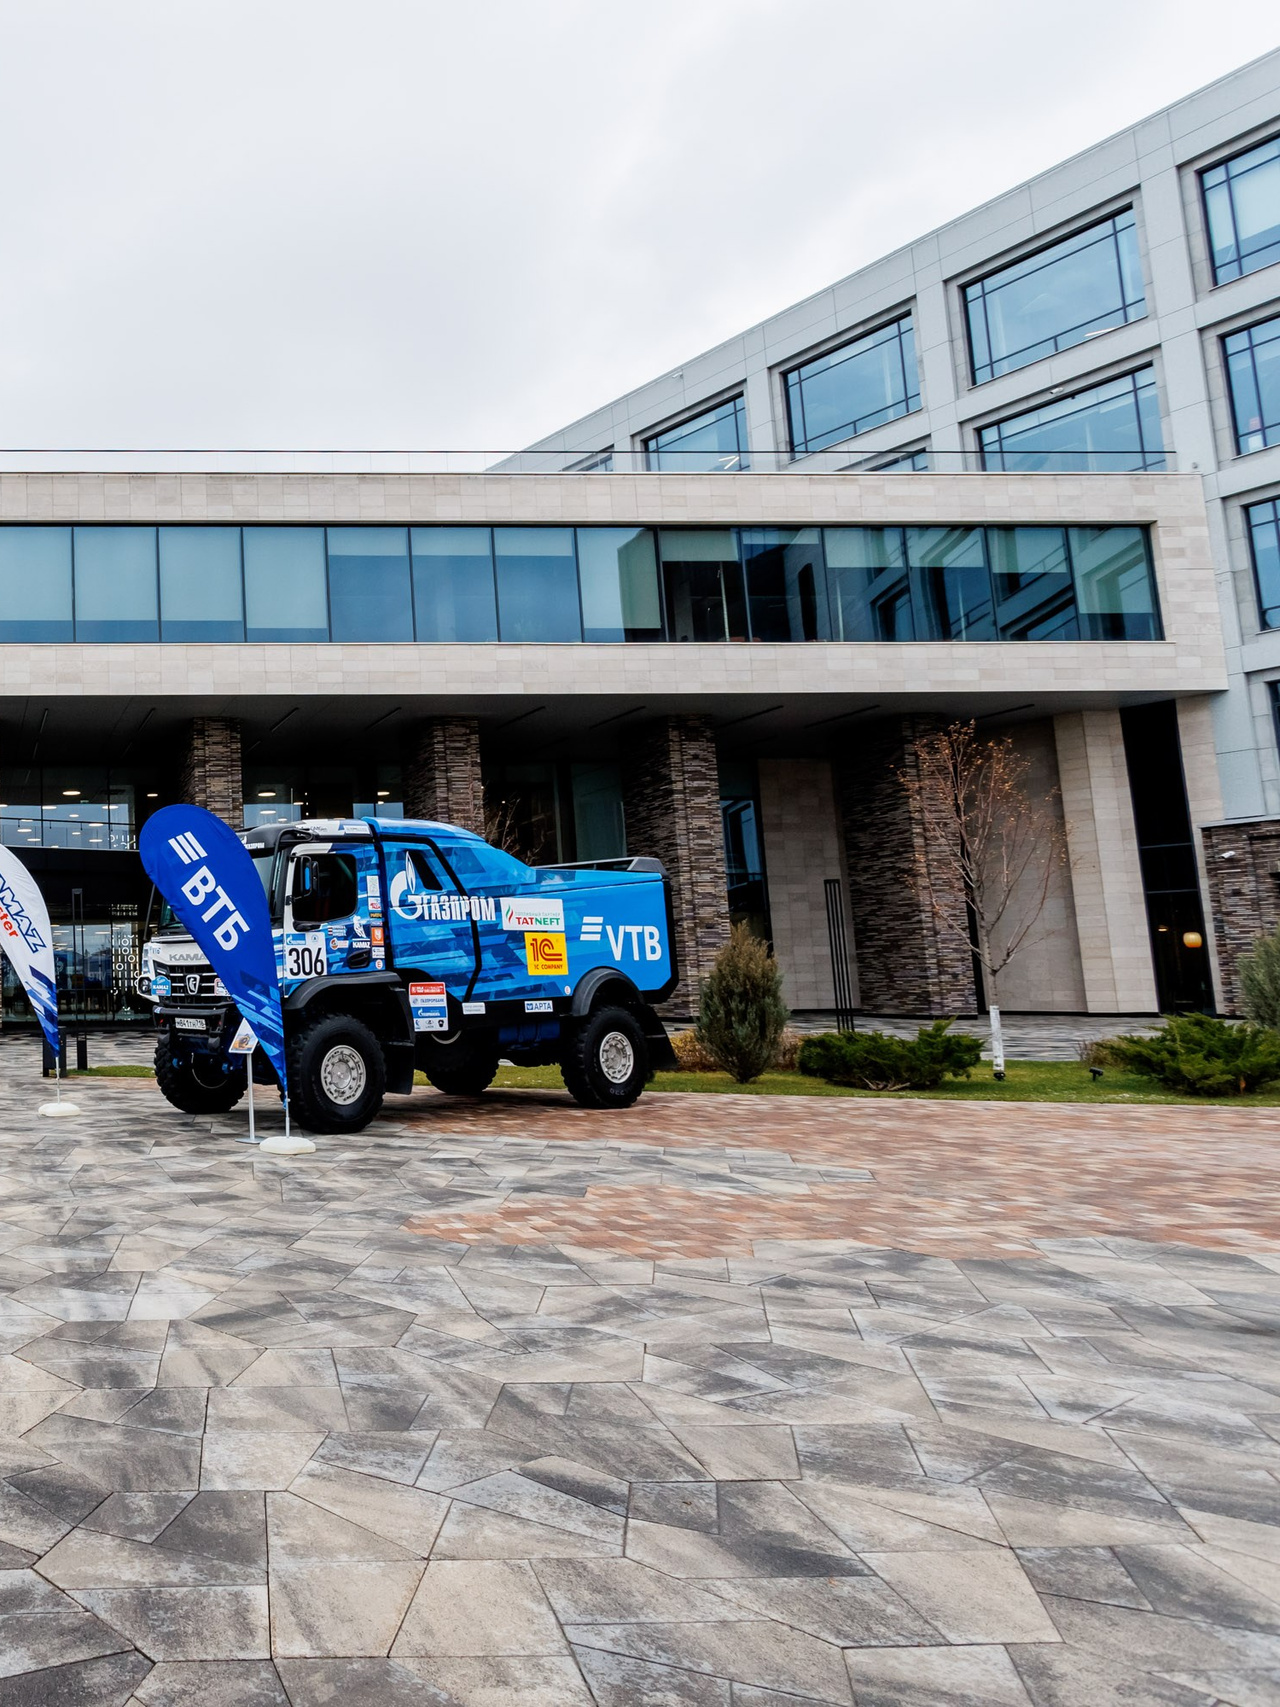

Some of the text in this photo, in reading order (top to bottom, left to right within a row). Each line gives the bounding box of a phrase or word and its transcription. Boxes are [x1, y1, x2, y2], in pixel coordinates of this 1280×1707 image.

[181, 865, 250, 951] ВТБ
[420, 896, 497, 920] ГАЗПРОМ
[516, 916, 560, 926] TATNEFT
[606, 925, 662, 961] VTB
[169, 953, 208, 961] KAMA
[289, 947, 325, 976] 306
